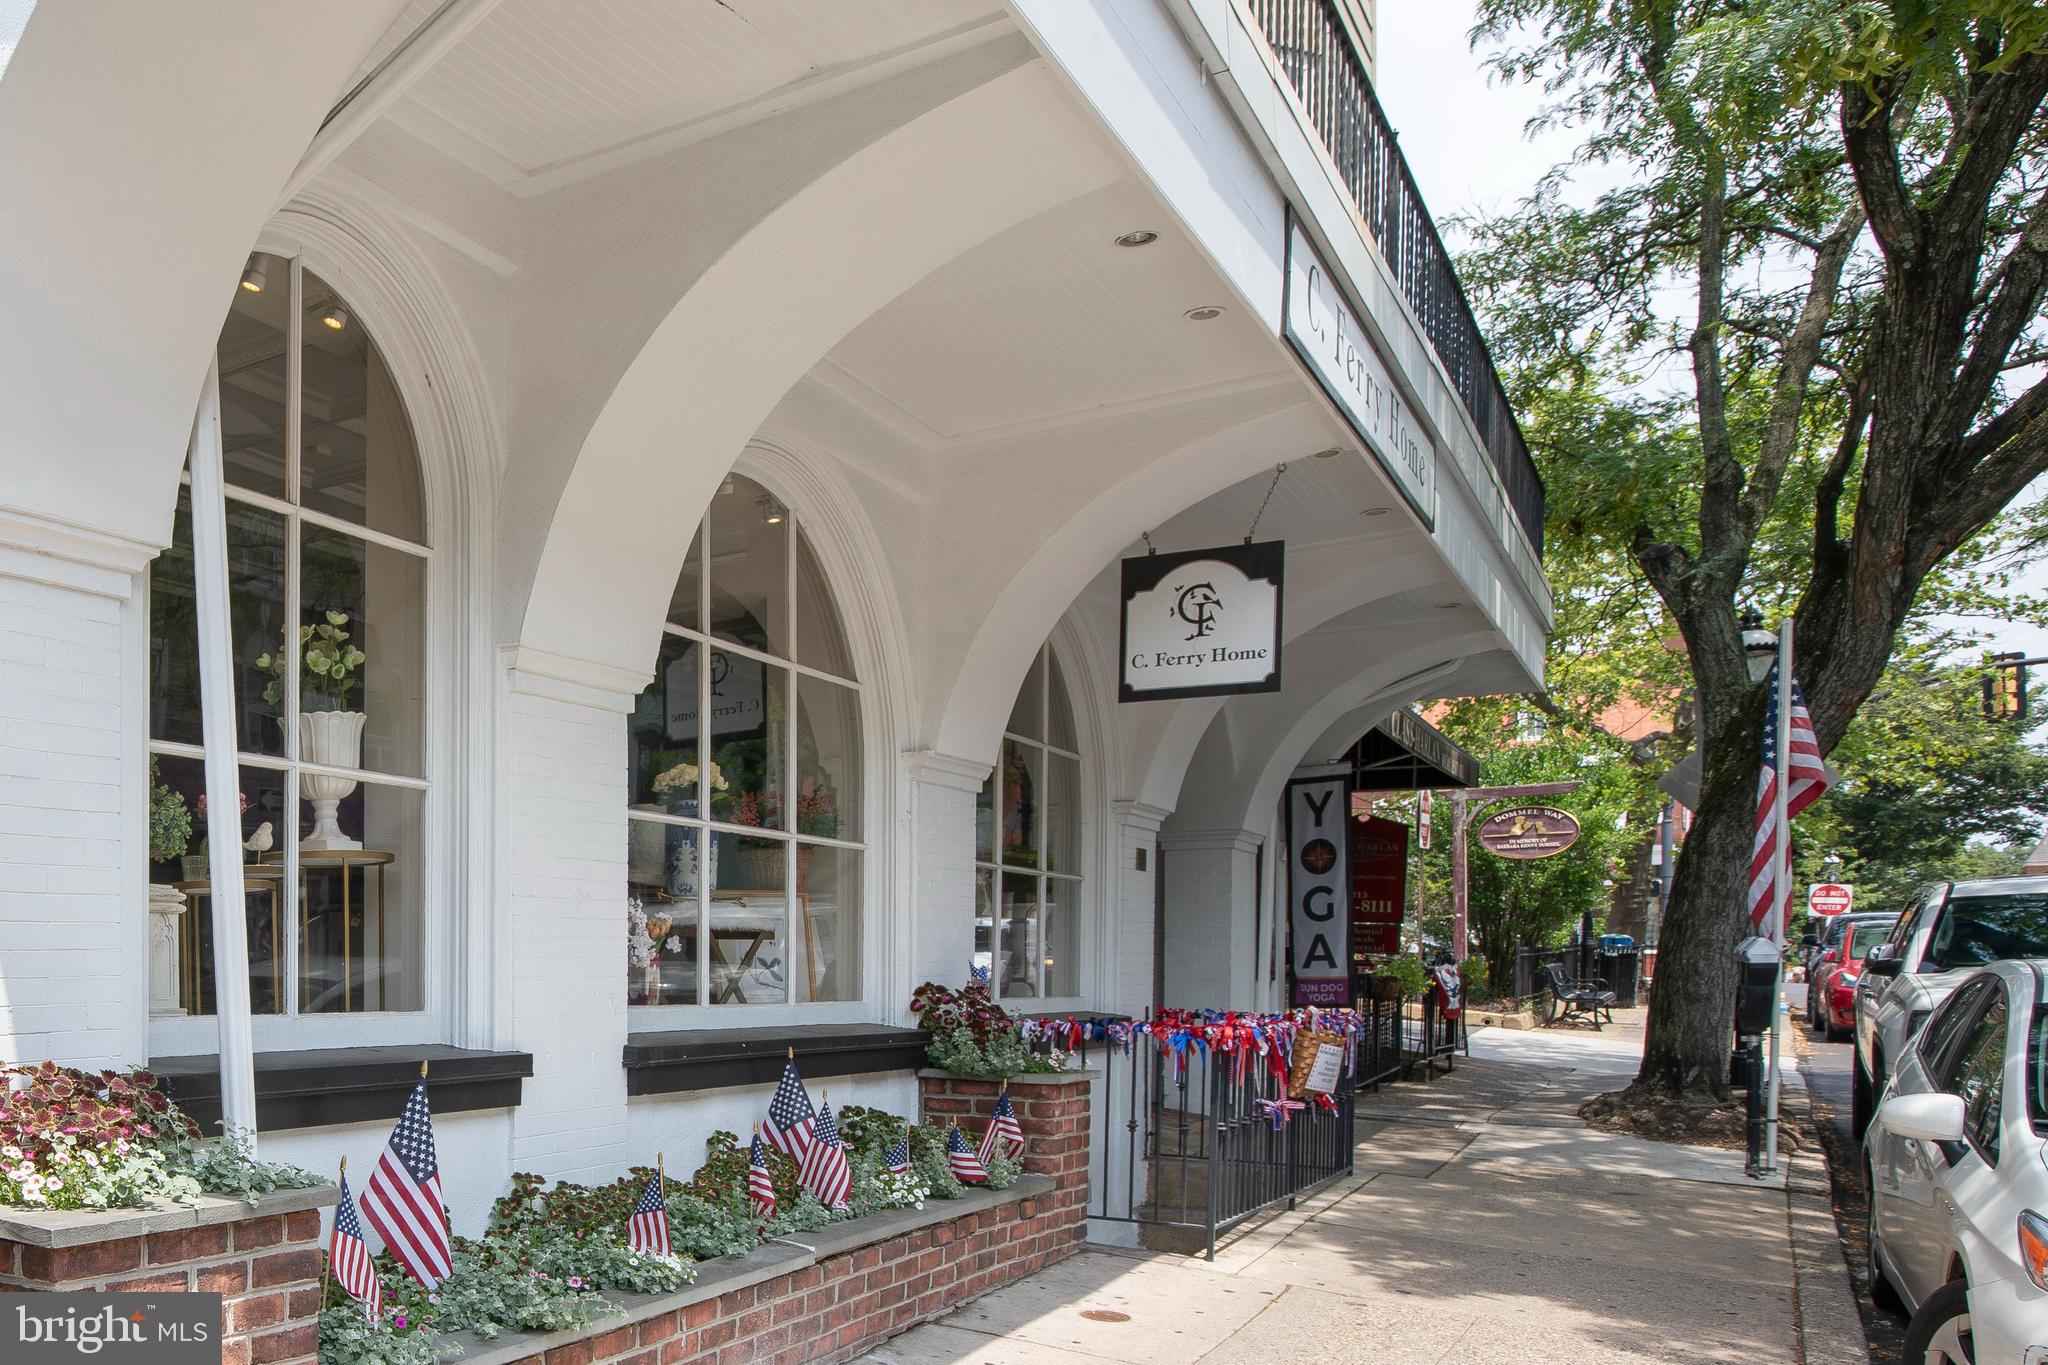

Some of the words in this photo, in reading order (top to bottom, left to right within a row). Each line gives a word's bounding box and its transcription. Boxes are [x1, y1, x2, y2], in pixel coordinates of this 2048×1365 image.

[1308, 265, 1325, 343] C.
[1334, 302, 1383, 434] Ferry
[1389, 388, 1426, 487] Home
[1131, 654, 1149, 669] C.
[1155, 651, 1207, 668] Ferry
[1212, 646, 1268, 663] Home
[1494, 808, 1540, 823] DOMMEL
[1544, 809, 1565, 820] WAY
[1300, 984, 1319, 992] SUN
[1320, 984, 1344, 992] DOG
[1308, 993, 1336, 1001] YOGA
